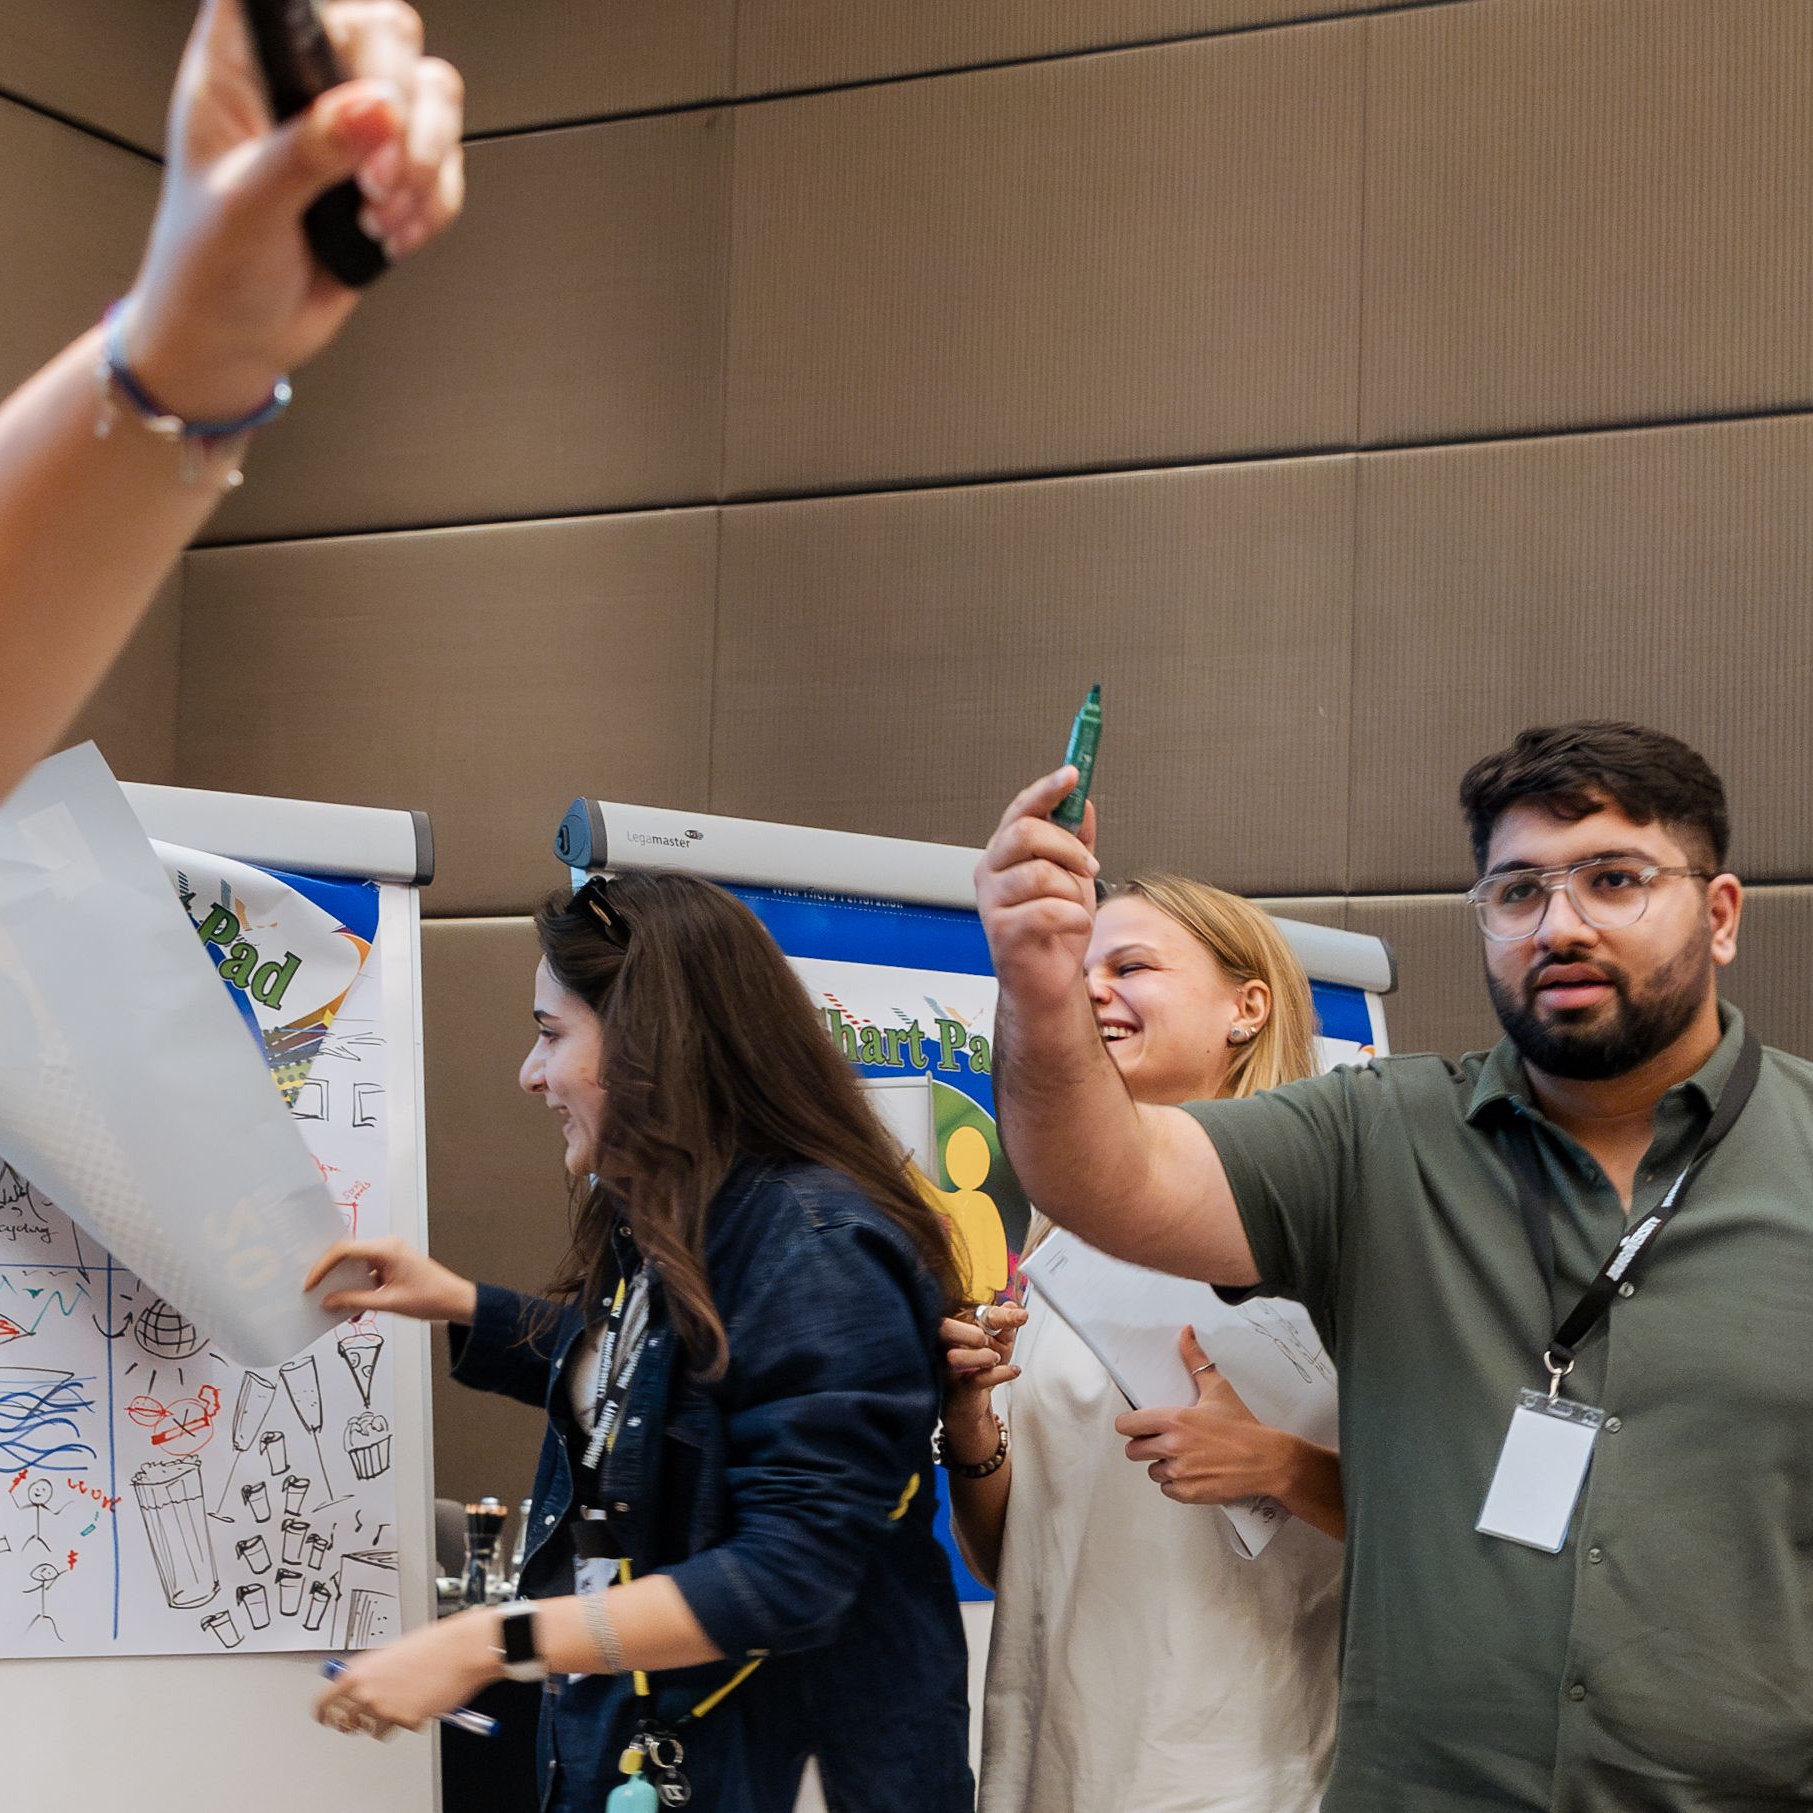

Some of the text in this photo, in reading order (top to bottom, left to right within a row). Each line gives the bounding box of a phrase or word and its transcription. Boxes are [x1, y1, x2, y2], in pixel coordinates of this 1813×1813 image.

[627, 830, 690, 848] Legamaster
[198, 902, 302, 1011] Pad
[825, 1007, 927, 1068] hart
